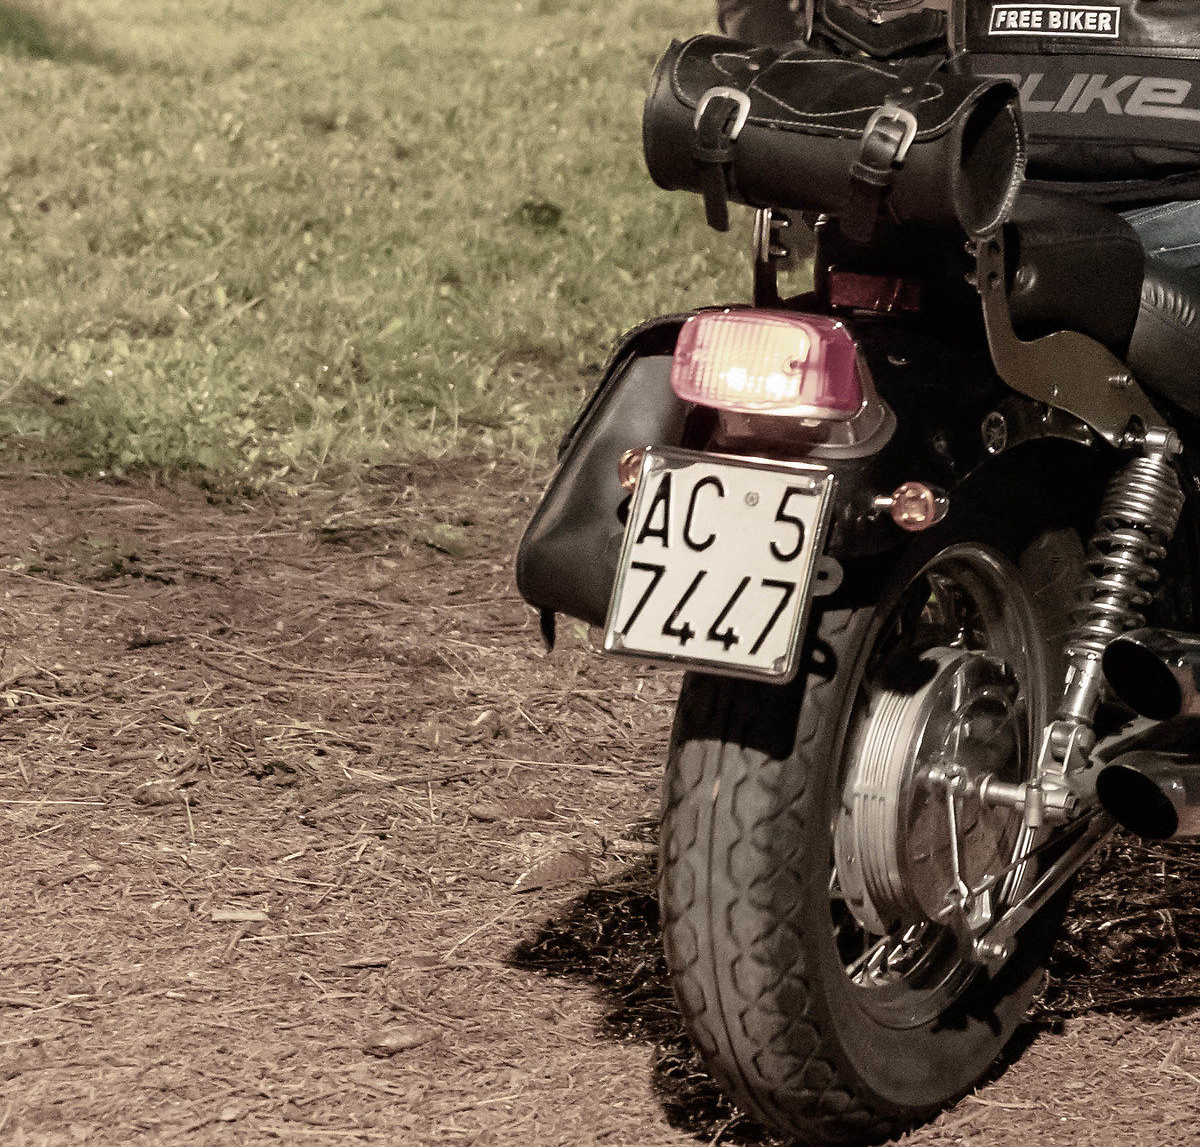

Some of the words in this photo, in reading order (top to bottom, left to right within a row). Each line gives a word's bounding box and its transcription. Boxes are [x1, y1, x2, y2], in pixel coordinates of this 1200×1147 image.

[995, 10, 1043, 29] FREE
[1048, 10, 1112, 31] BIKER
[636, 471, 725, 553] AC
[770, 486, 818, 563] 5
[620, 561, 797, 656] 7447
